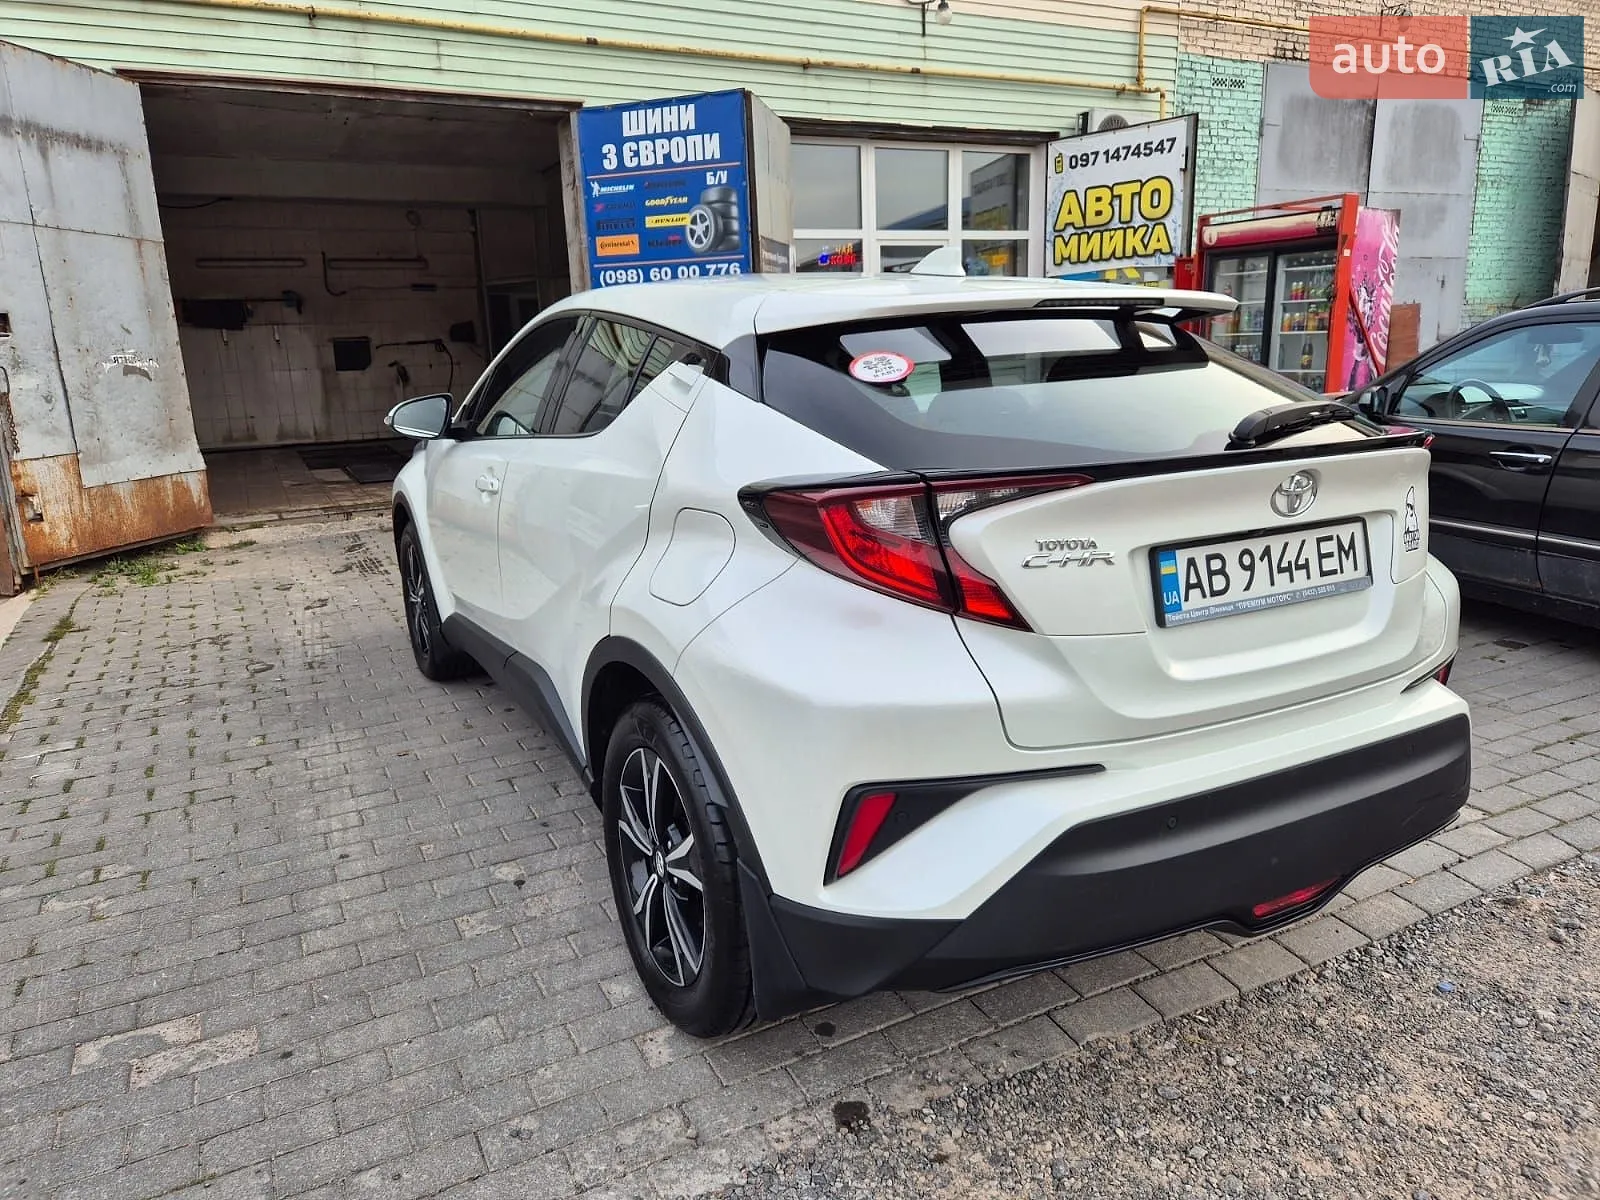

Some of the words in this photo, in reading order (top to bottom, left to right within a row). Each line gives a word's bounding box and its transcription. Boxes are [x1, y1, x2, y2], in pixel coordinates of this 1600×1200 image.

[622, 104, 695, 137] ШИНИ
[623, 133, 720, 168] ЄВРОПИ
[600, 184, 635, 192] MICHELIN
[706, 171, 728, 185] Б/У
[1054, 176, 1173, 232] АВТО
[1053, 222, 1173, 265] МИЙКА
[600, 268, 643, 287] (098)
[650, 267, 672, 281] 60
[678, 265, 700, 279] 00
[705, 263, 741, 277] 776
[1035, 537, 1098, 551] TOYOTA
[1022, 551, 1116, 569] C-HR
[1184, 554, 1231, 602] AB
[1239, 539, 1311, 592] 9144
[1318, 530, 1359, 577] EM
[1163, 591, 1180, 605] UA
